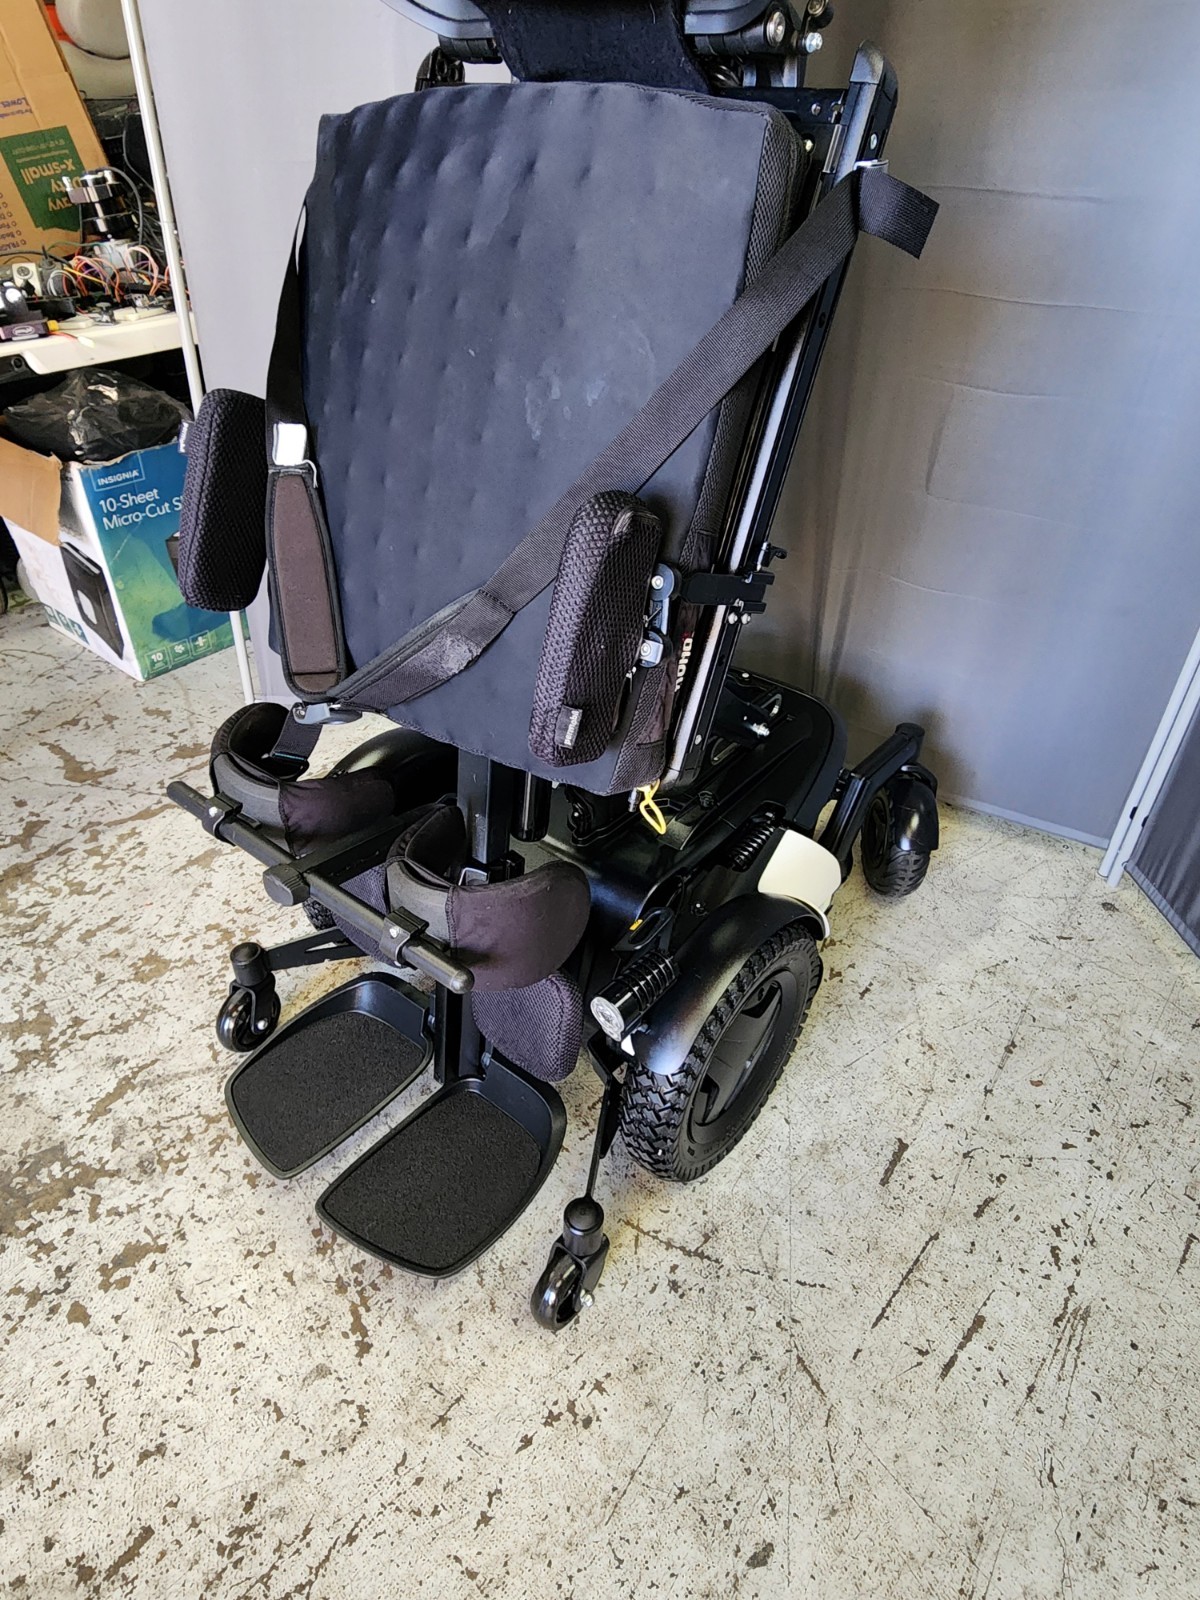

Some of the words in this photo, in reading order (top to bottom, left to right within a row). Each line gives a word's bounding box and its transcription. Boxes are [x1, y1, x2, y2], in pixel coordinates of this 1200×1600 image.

[20, 158, 76, 185] x-small
[51, 178, 82, 193] Dty
[48, 197, 72, 212] avy
[97, 469, 140, 486] INSIGNIA
[99, 488, 160, 513] 10-Sheet
[102, 502, 171, 531] Micro-Cut
[172, 495, 183, 511] S
[151, 652, 164, 663] 10
